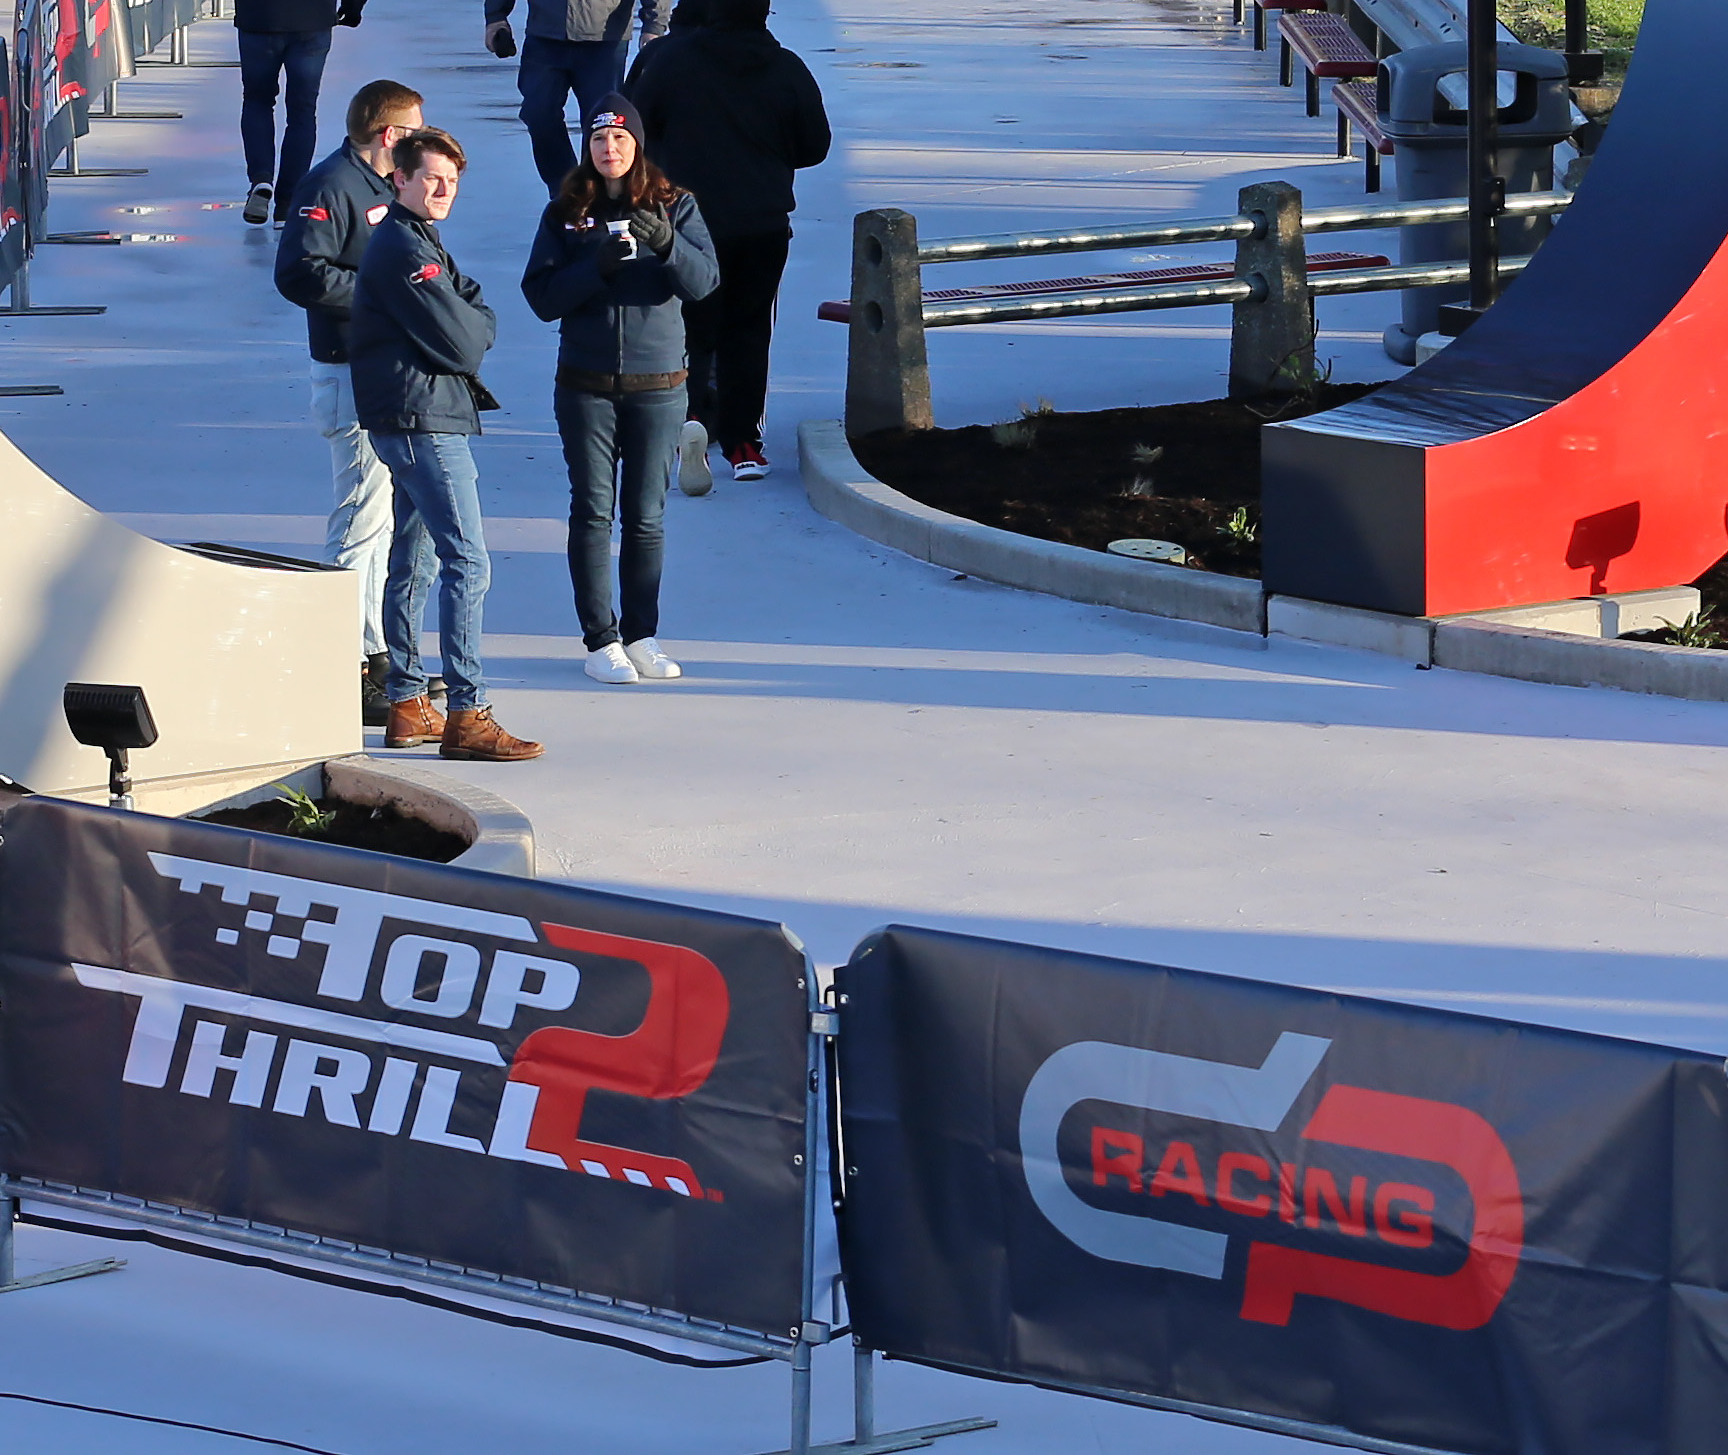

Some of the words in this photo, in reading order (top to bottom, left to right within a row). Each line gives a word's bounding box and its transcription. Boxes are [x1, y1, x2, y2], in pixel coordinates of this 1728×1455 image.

[71, 962, 569, 1169] THRILL
[145, 850, 581, 1031] TOP
[507, 921, 730, 1198] 2
[1088, 1126, 1436, 1249] RACING
